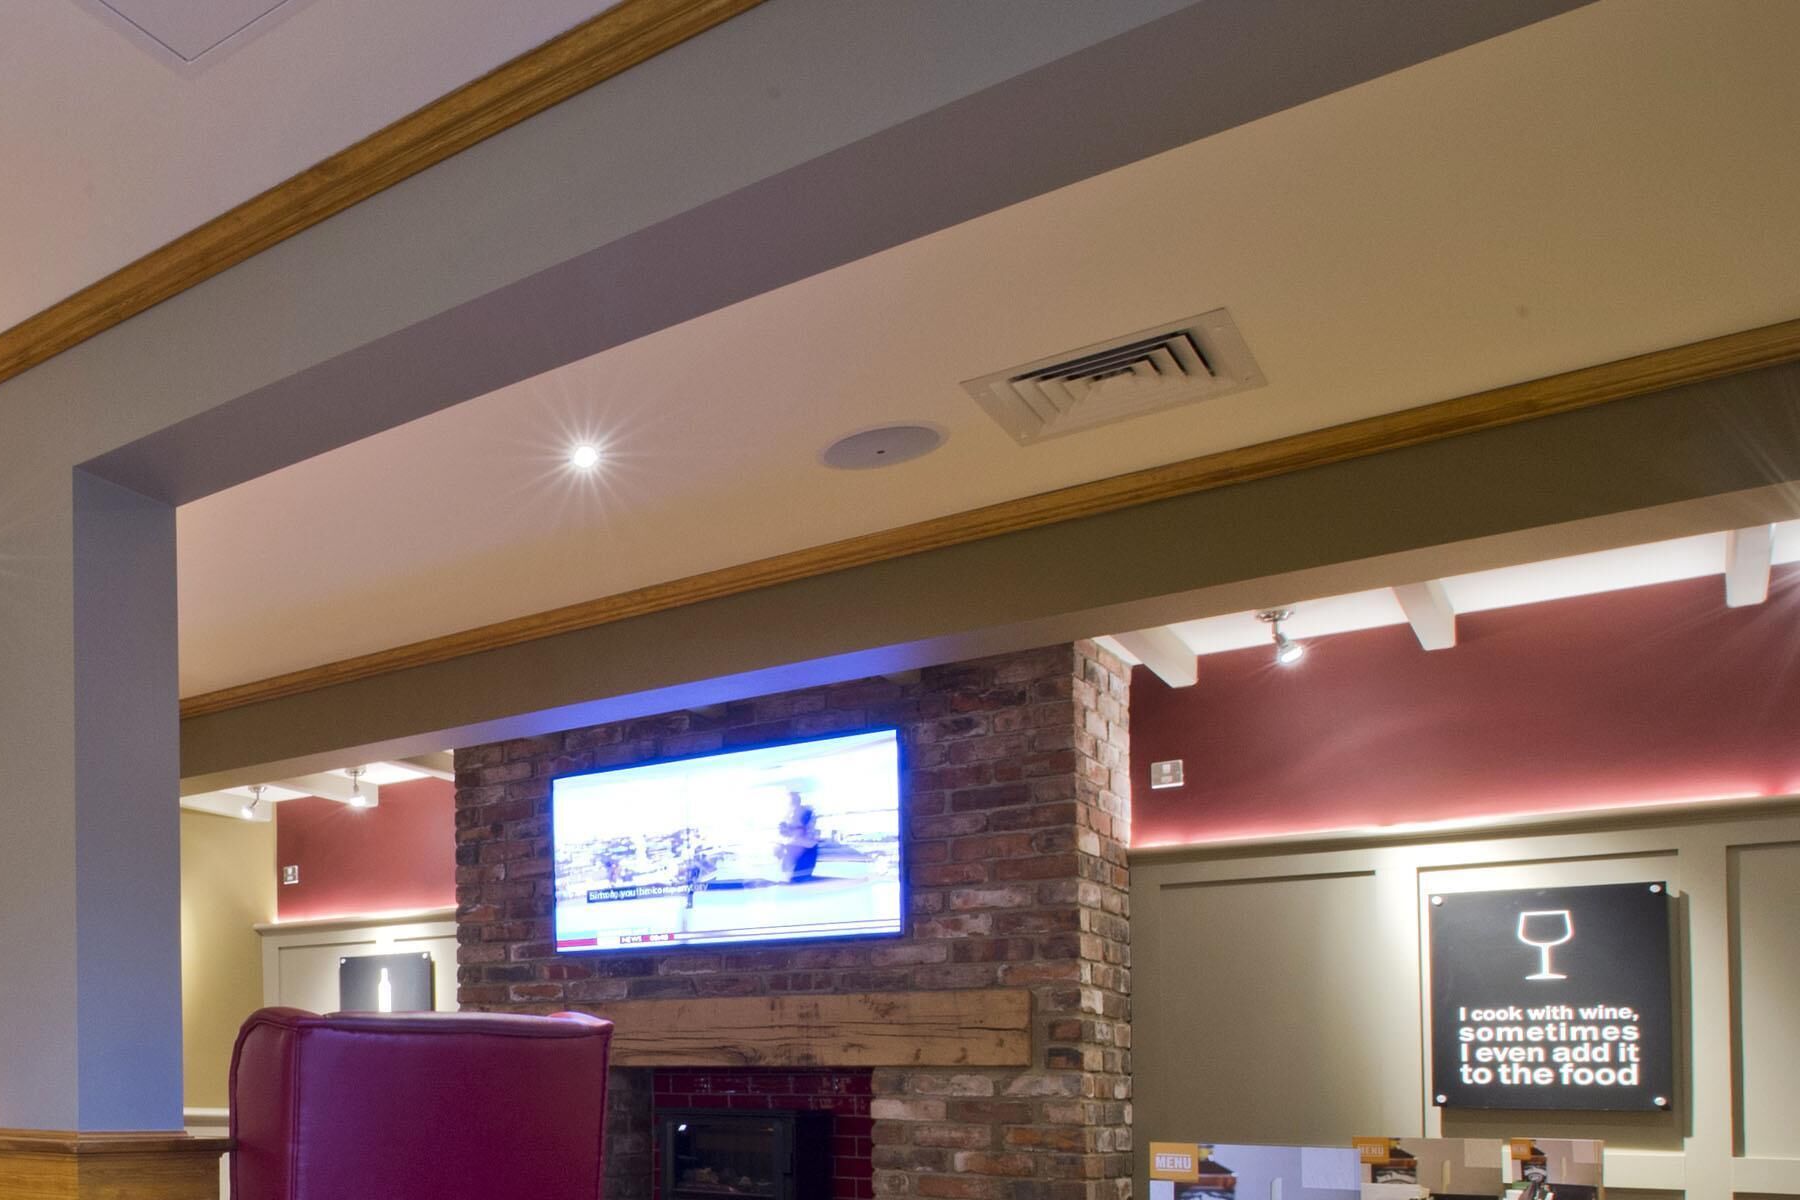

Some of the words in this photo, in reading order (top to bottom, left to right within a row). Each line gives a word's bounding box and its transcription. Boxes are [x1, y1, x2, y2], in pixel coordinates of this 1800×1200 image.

[1458, 1006, 1467, 1021] I
[1471, 1005, 1523, 1021] cook
[1527, 1004, 1574, 1021] with
[1578, 1004, 1640, 1021] wine,
[1458, 1022, 1640, 1042] sometimes
[1460, 1043, 1469, 1062] I
[1475, 1046, 1545, 1062] even
[1552, 1043, 1611, 1062] add
[1618, 1043, 1640, 1062] it
[1460, 1063, 1493, 1085] to
[1498, 1063, 1555, 1085] the
[1559, 1063, 1640, 1085] food
[1155, 1155, 1192, 1169] MENU
